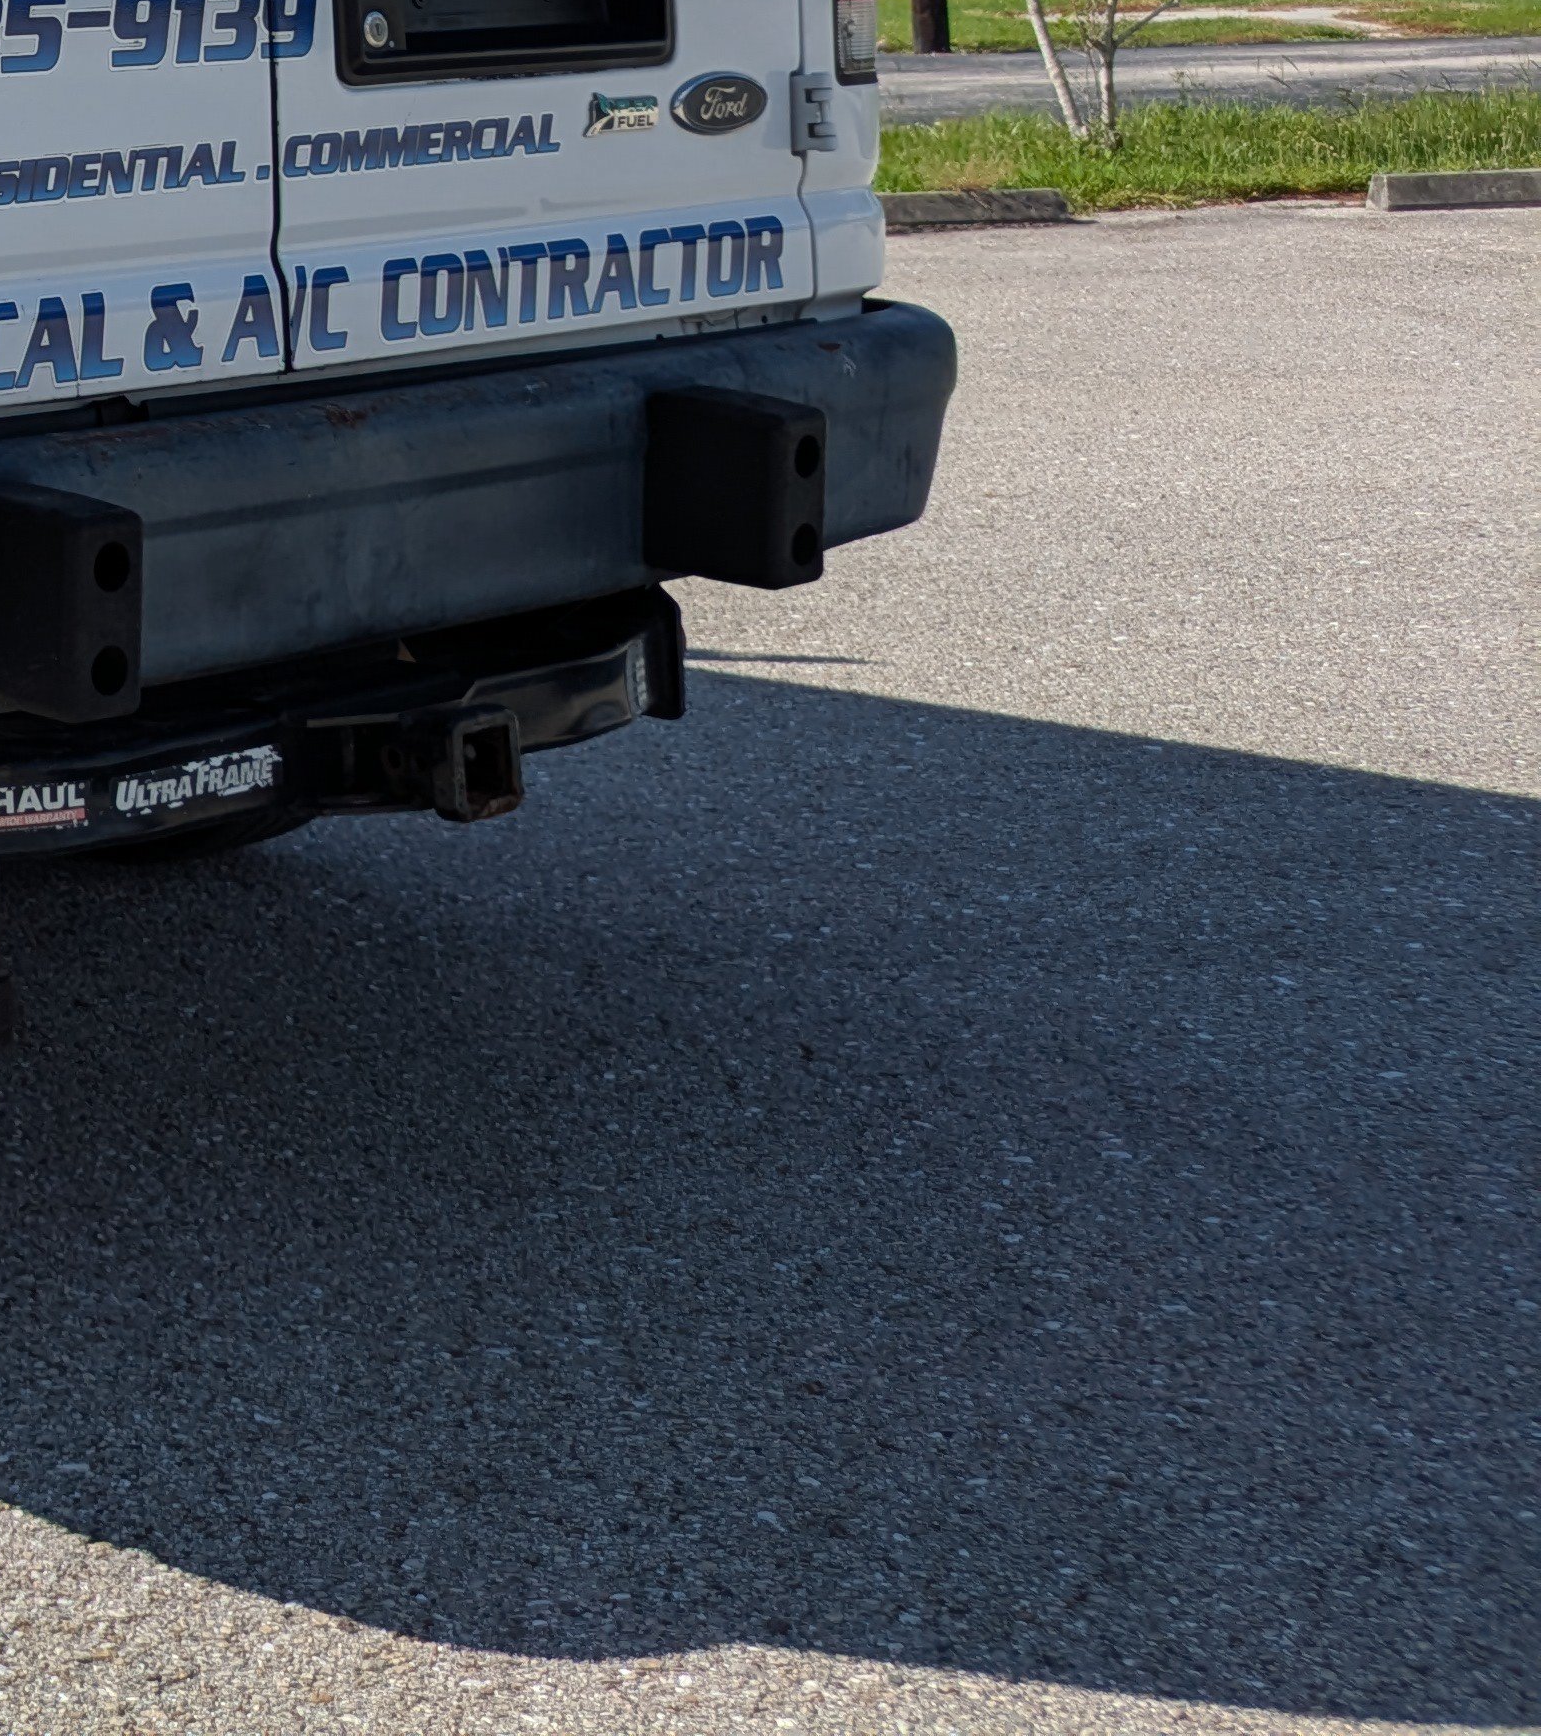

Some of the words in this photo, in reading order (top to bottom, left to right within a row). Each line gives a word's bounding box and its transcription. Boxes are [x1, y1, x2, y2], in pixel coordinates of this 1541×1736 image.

[617, 114, 655, 128] FUEL
[699, 86, 750, 121] Ford
[281, 113, 562, 180] COMMERCIAL
[143, 282, 204, 373] &
[222, 265, 352, 365] A/C
[380, 214, 785, 341] CONTRACTOR
[24, 810, 77, 826] WARRANTY
